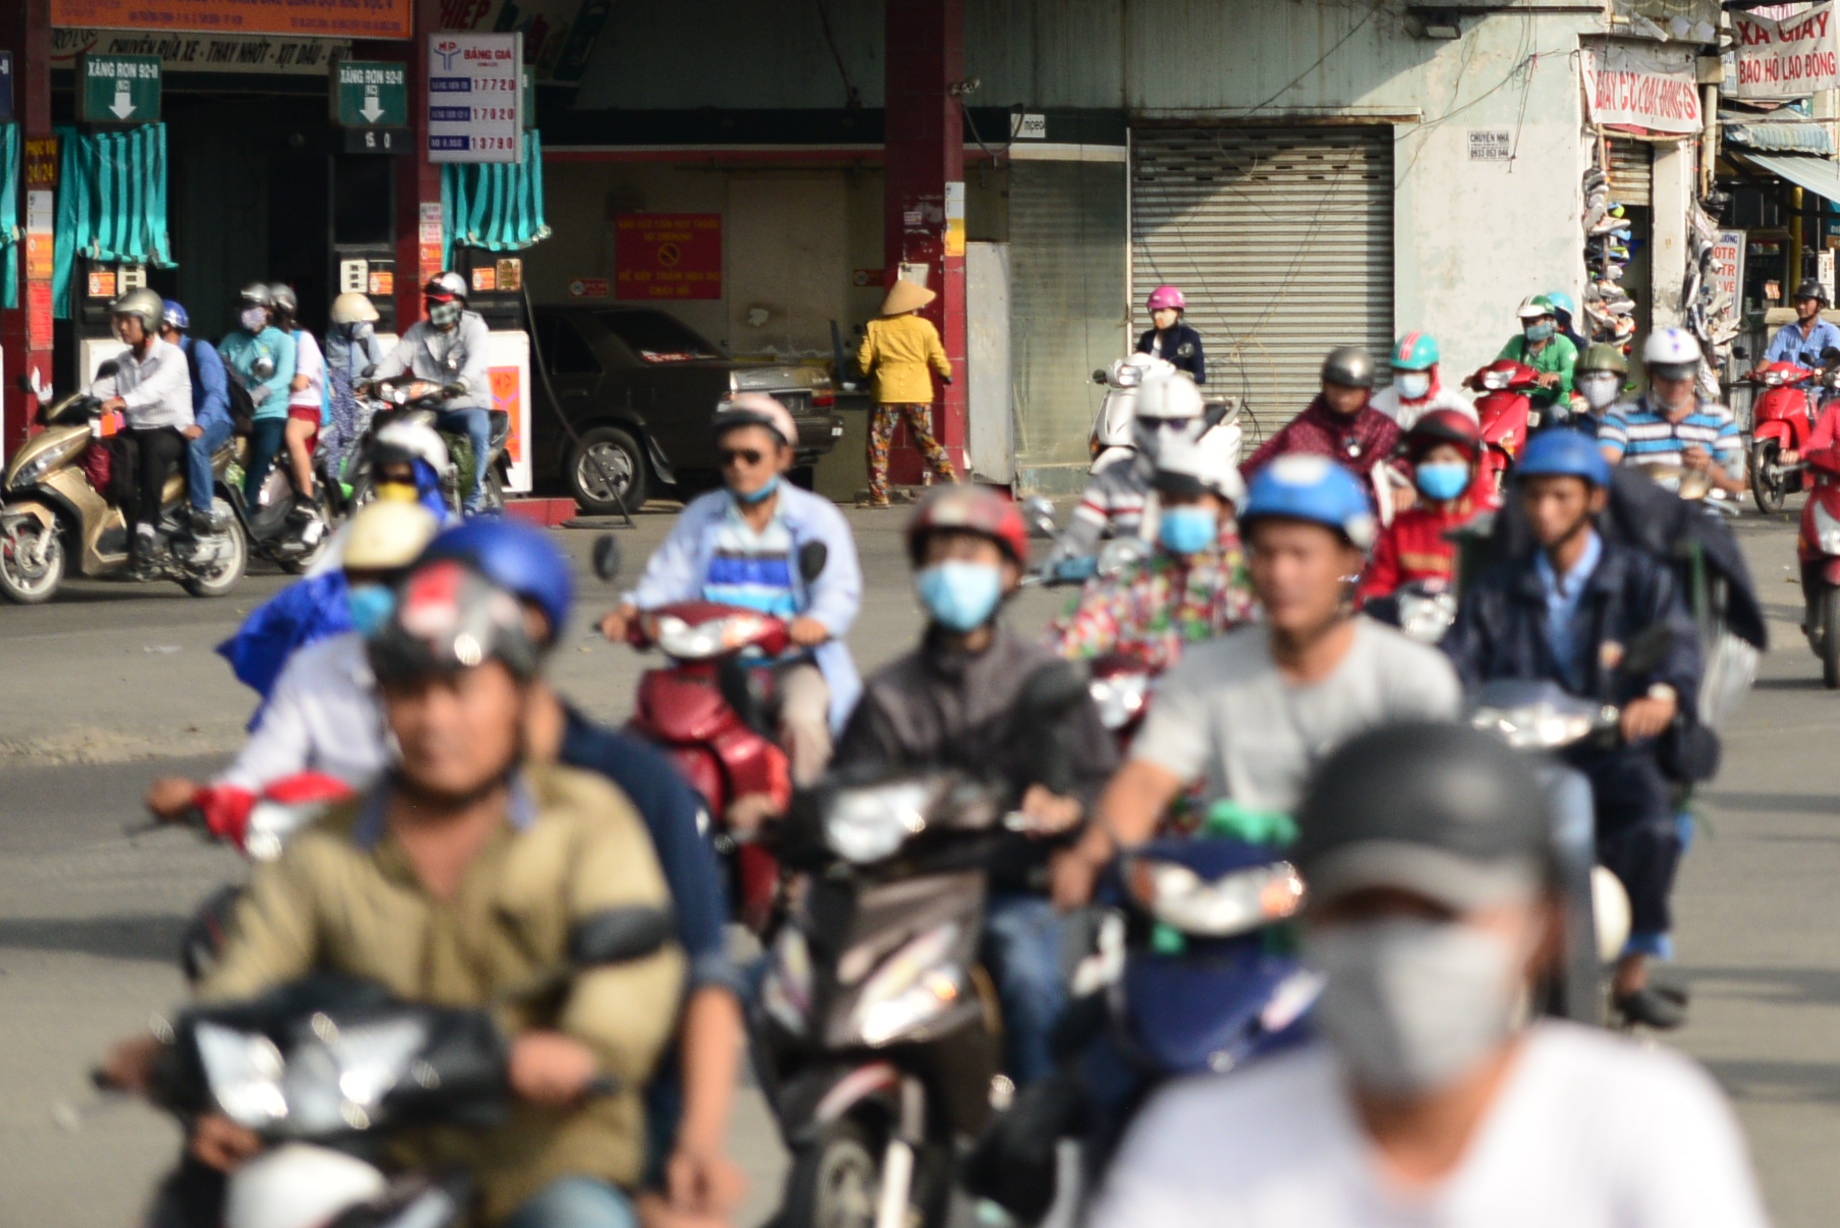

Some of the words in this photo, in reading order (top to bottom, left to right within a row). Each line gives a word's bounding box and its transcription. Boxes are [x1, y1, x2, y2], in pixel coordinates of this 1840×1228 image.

[1739, 51, 1761, 84] BẢO
[1764, 52, 1779, 87] HỘ
[1782, 54, 1802, 81] LAO
[1805, 46, 1837, 82] ĐỘNG
